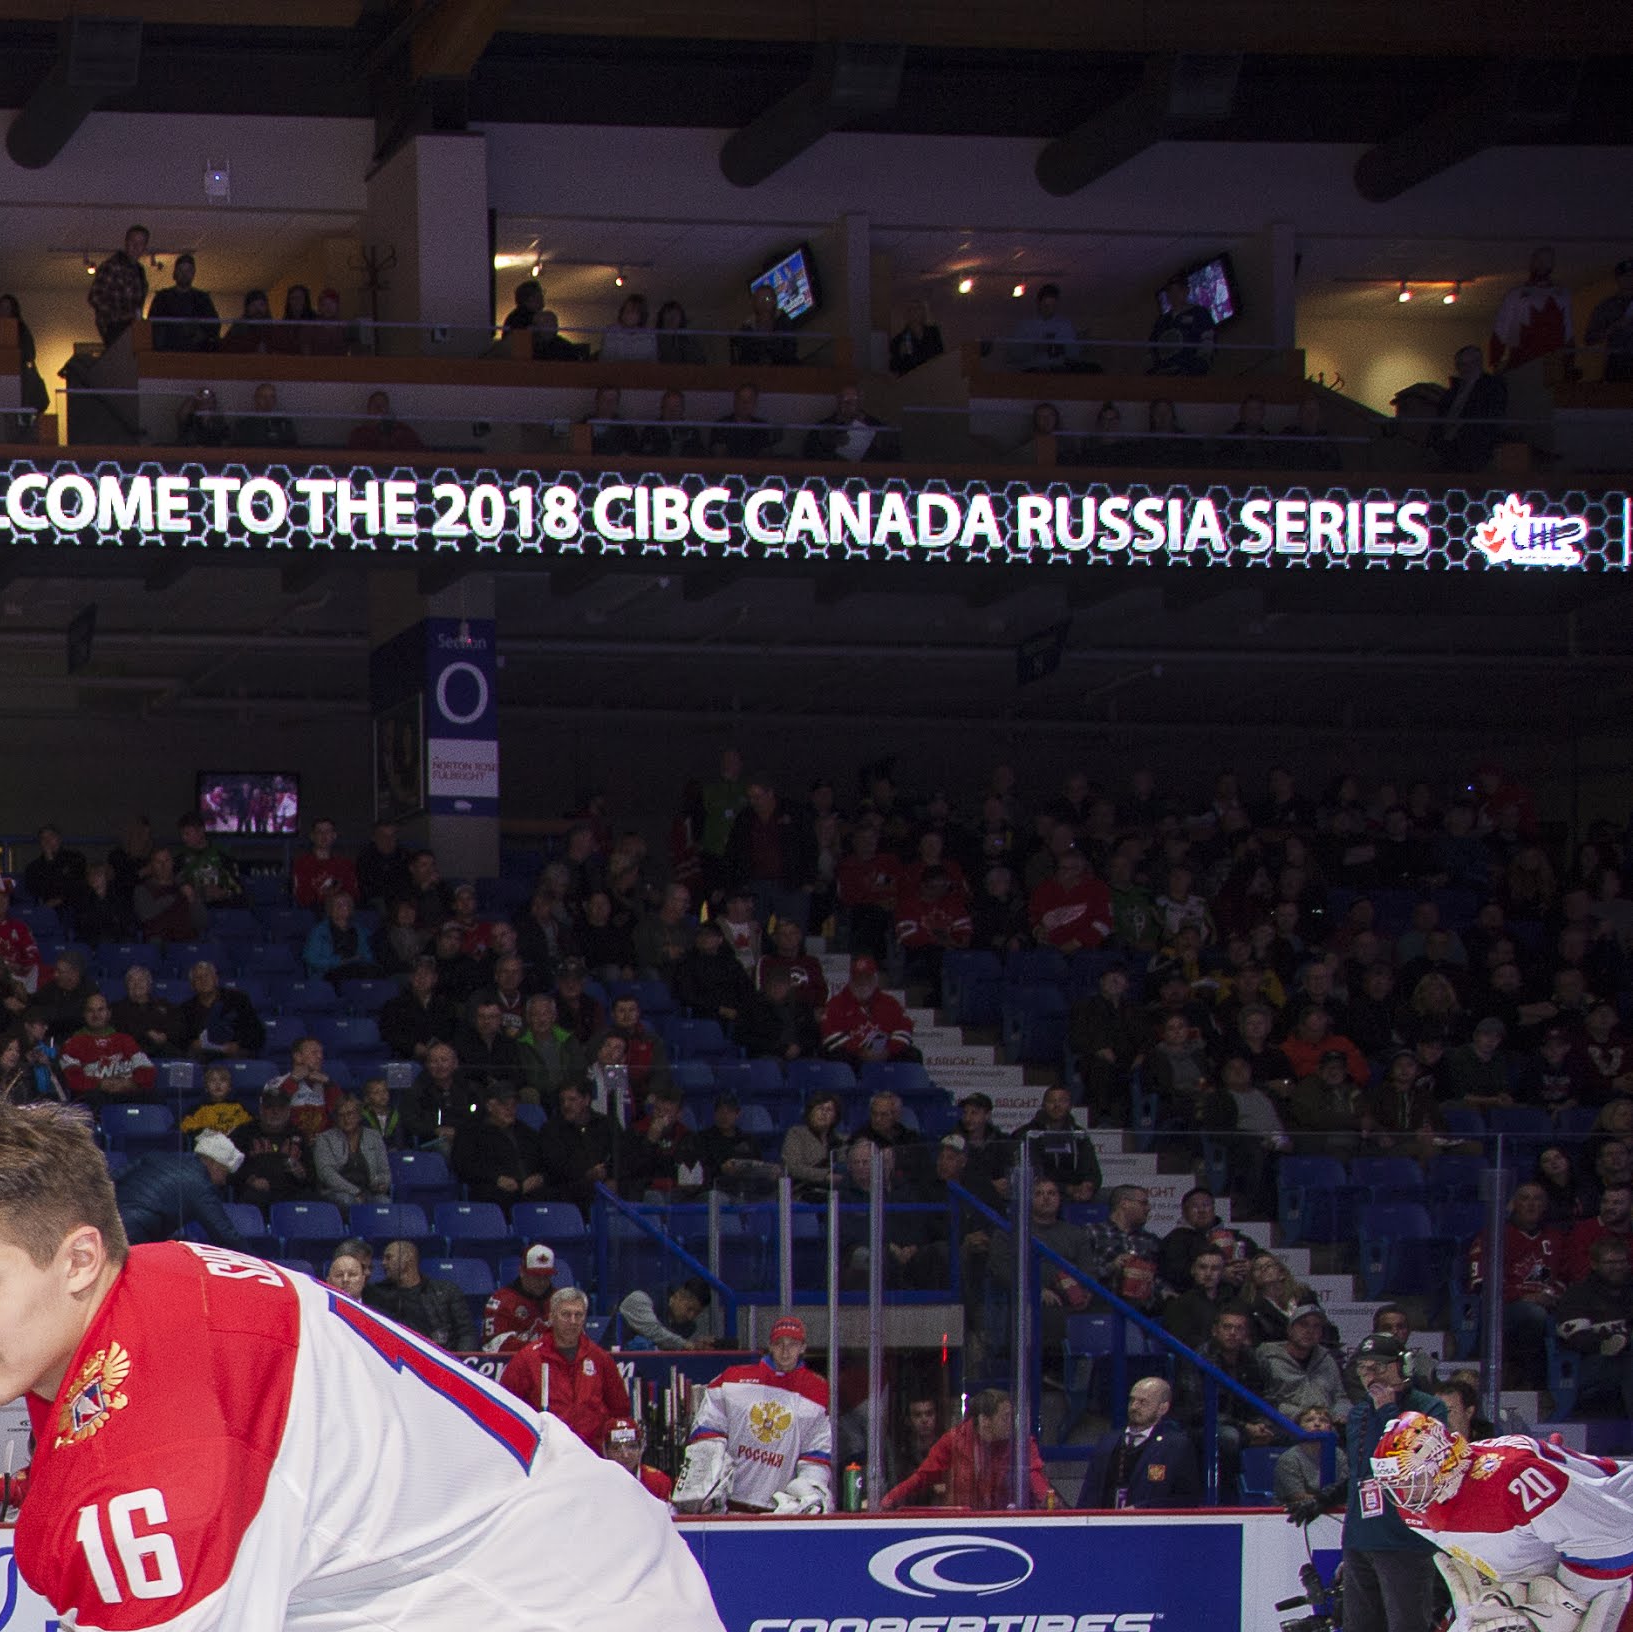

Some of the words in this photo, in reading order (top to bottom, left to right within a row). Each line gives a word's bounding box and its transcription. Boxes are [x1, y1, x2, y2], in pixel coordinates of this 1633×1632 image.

[201, 476, 288, 534] TO
[296, 478, 418, 537] THE
[432, 482, 579, 540] 2018
[594, 485, 731, 543] CIBC
[743, 489, 1005, 549] CANADA
[1017, 493, 1228, 553] RUSSIA
[1239, 497, 1432, 556] SERIES
[436, 661, 488, 724] O
[738, 1445, 784, 1468] РОССИЯ
[1508, 1467, 1557, 1513] 20
[76, 1488, 183, 1605] 16
[1561, 1601, 1585, 1615] CC
